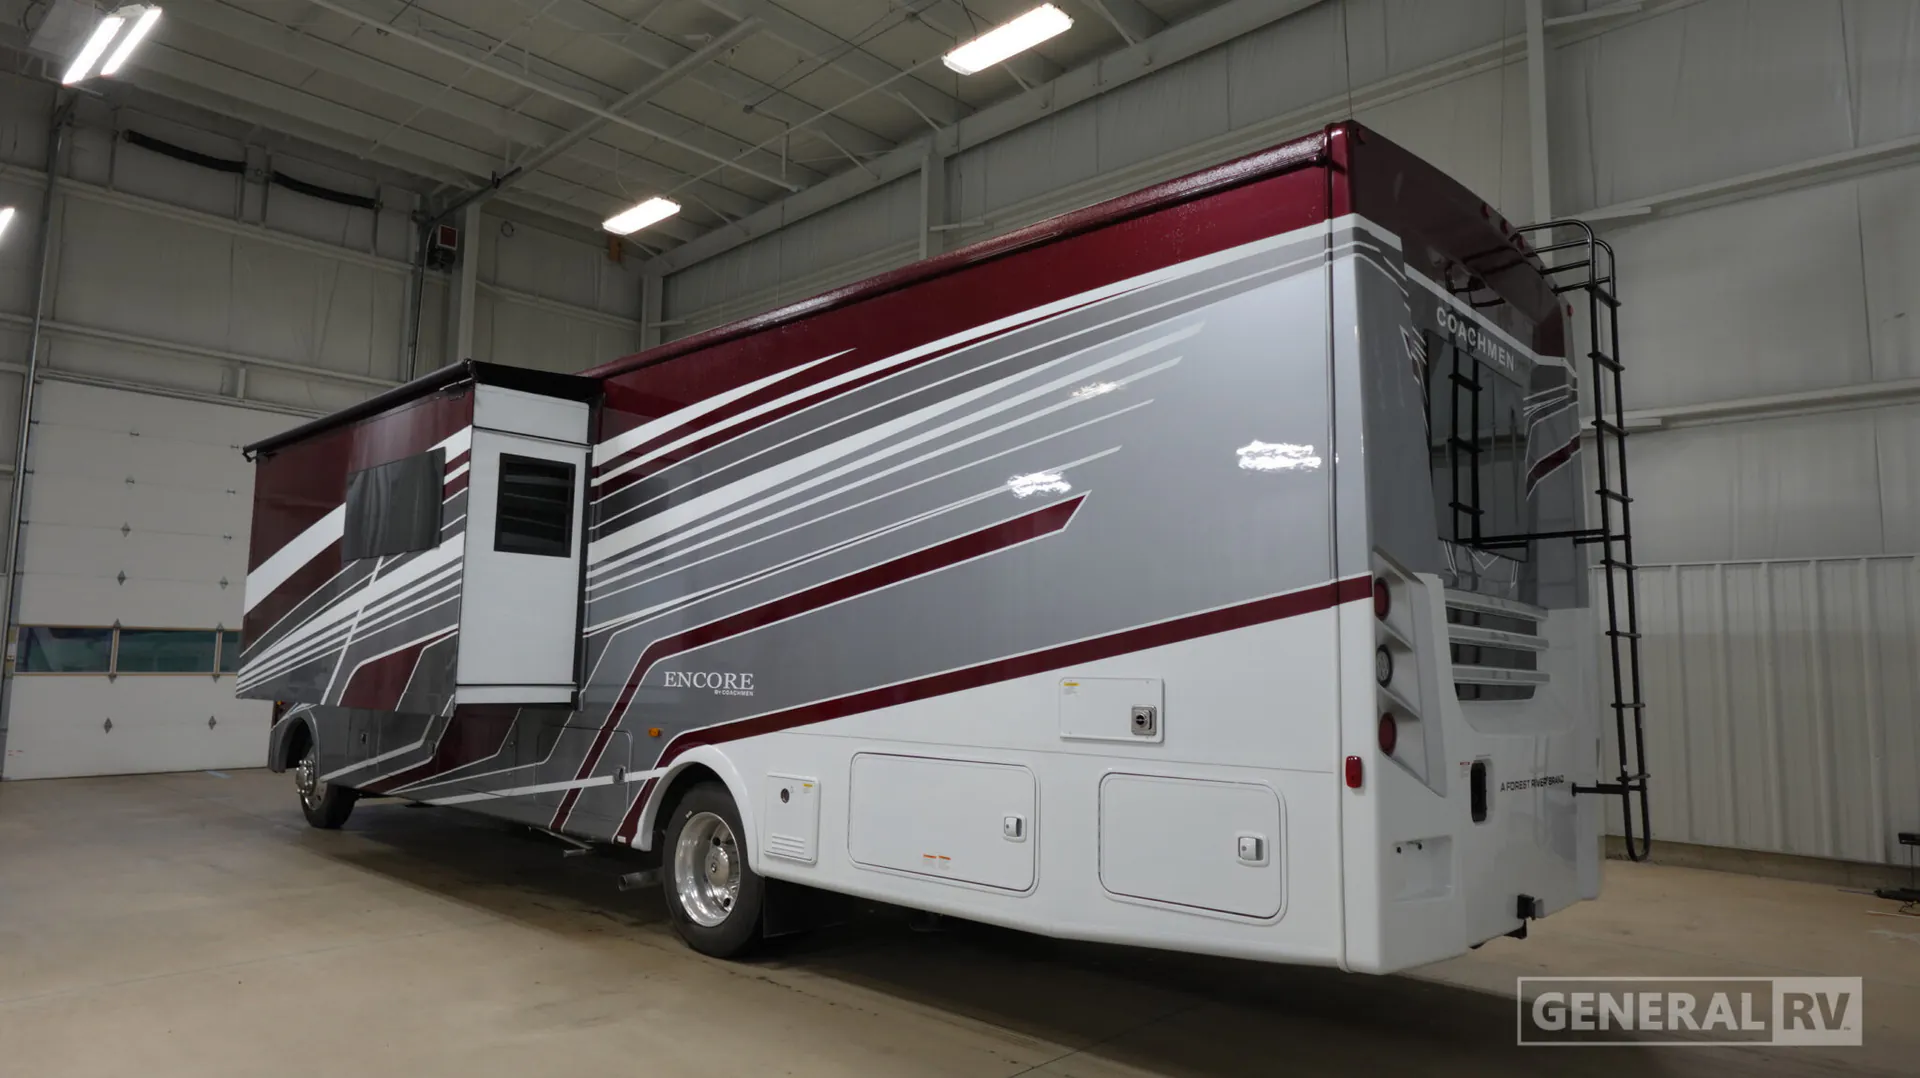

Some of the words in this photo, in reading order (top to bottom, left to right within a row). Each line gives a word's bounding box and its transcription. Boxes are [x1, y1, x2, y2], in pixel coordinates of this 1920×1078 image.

[1436, 306, 1514, 372] COACHMEN
[664, 671, 754, 690] ENCORE
[1500, 782, 1505, 792] A
[1506, 780, 1530, 791] FOREST
